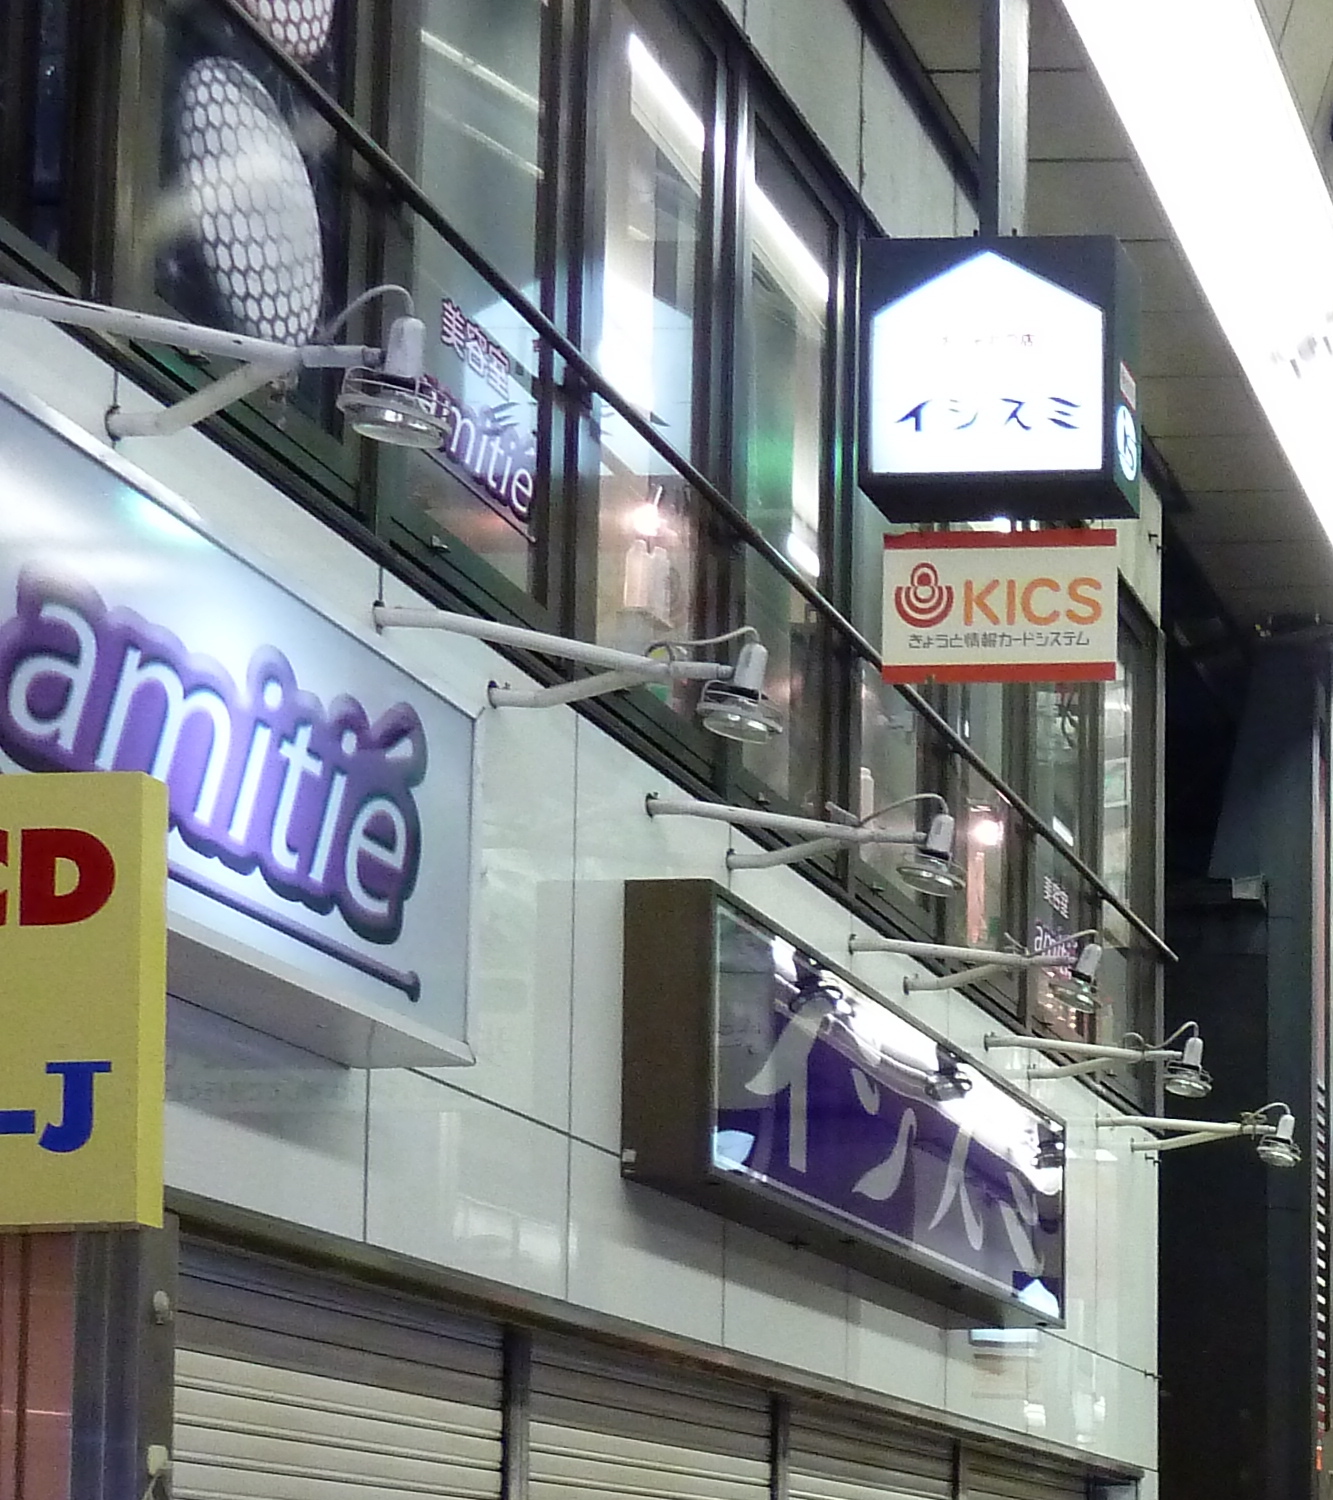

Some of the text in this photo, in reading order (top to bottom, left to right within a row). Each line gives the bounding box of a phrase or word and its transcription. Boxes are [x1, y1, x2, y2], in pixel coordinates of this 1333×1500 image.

[441, 299, 511, 401] 美容室
[908, 630, 1090, 649] きょうと情報カードシステム
[963, 576, 1103, 627] KICS
[6, 598, 412, 922] amitié
